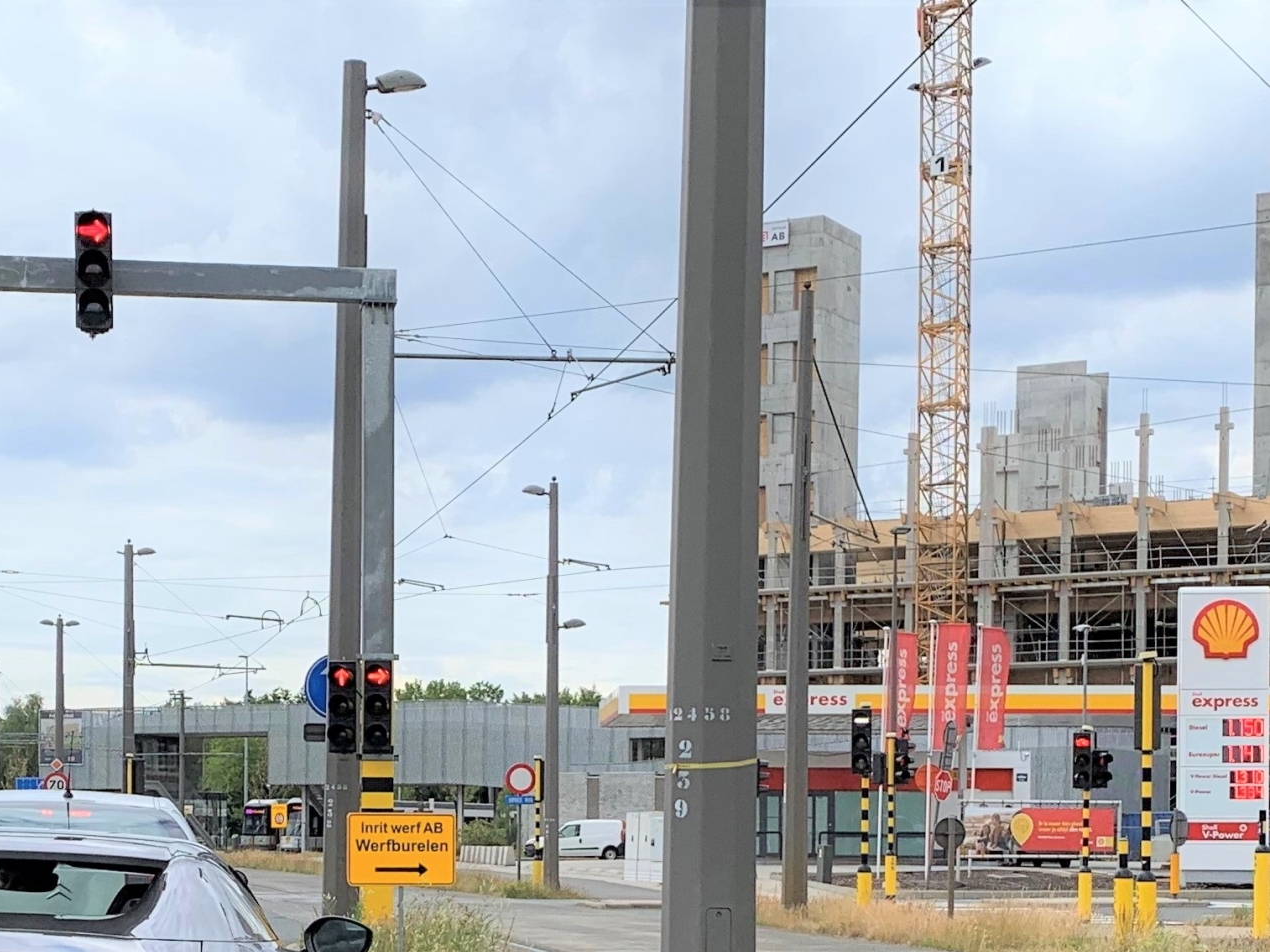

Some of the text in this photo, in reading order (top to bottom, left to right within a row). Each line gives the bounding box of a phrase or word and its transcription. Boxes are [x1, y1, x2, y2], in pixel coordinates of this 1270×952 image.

[935, 157, 945, 172] 1
[771, 231, 785, 241] AB
[944, 641, 959, 722] express
[988, 643, 1004, 723] express
[1192, 697, 1259, 711] express
[49, 780, 64, 790] 70
[935, 780, 951, 792] STOP
[361, 821, 443, 834] Inrit werf AB
[1202, 831, 1244, 839] V-Power
[356, 838, 449, 852] Werfburelen
